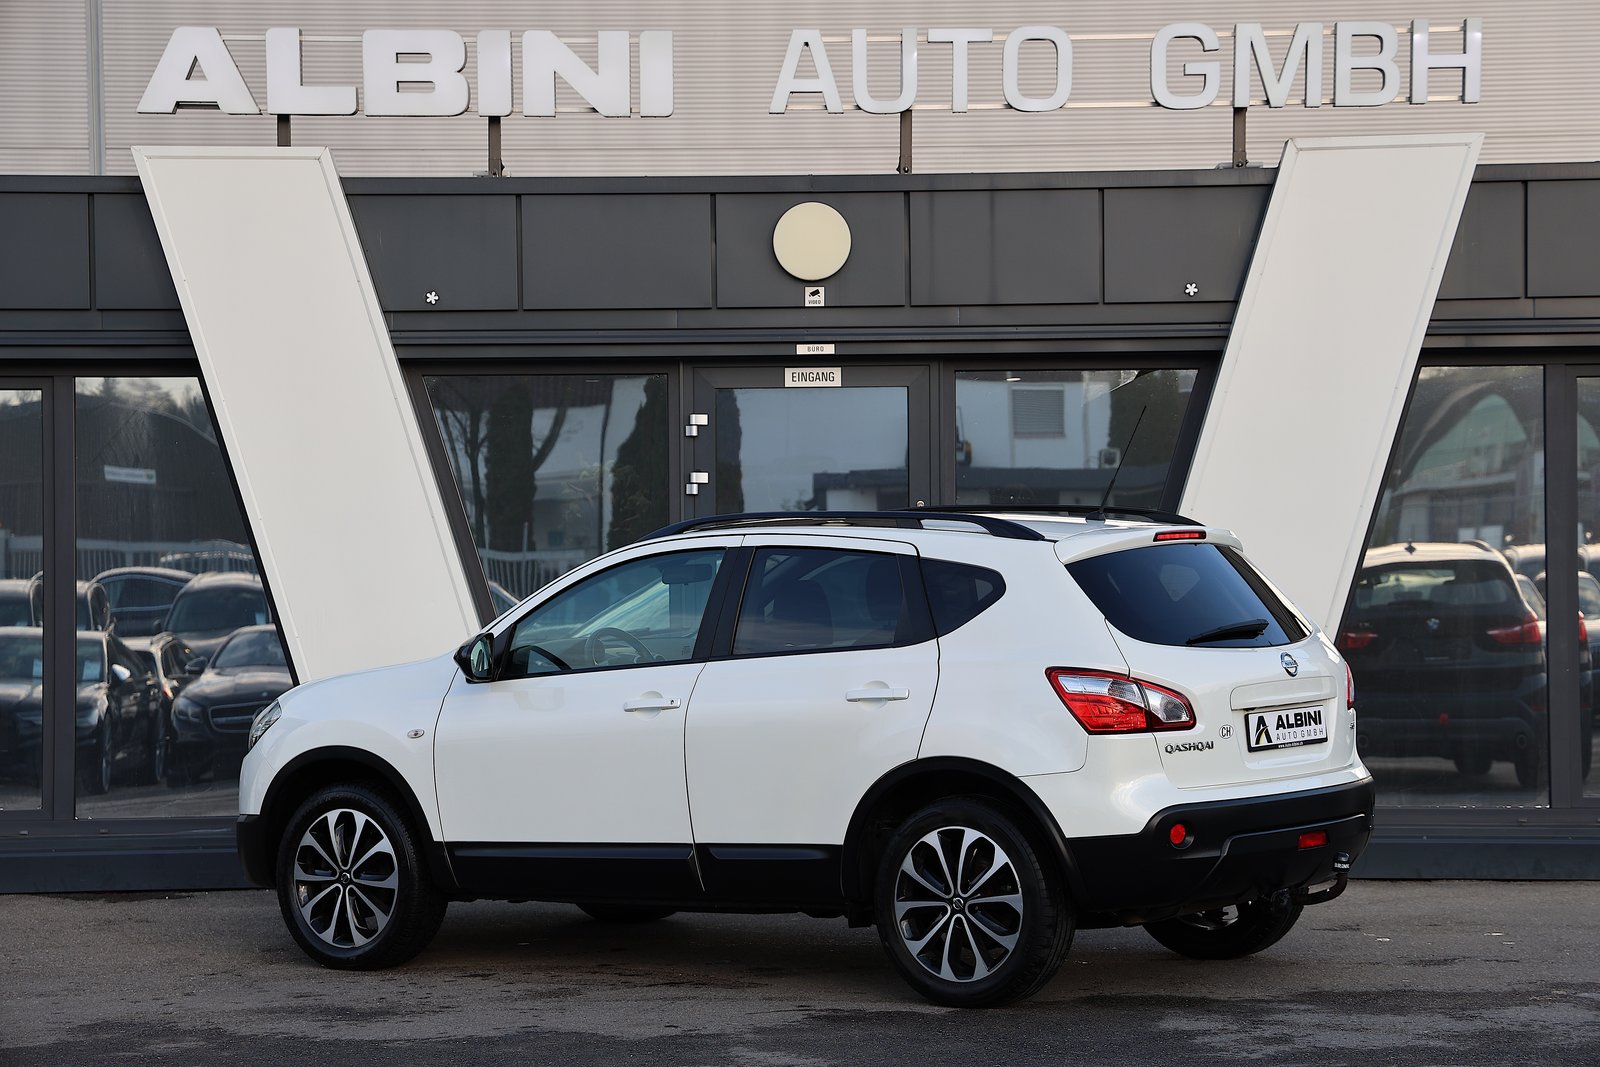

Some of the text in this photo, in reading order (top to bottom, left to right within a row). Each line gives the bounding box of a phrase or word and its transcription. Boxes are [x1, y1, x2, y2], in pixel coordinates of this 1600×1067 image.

[136, 17, 1483, 118] ALBINI AUTO GMBH
[791, 371, 835, 383] EINGANG
[1276, 710, 1322, 730] ALBINI
[1221, 726, 1231, 737] CH
[1276, 728, 1324, 741] AUTO GMBH
[1164, 740, 1214, 754] QASHQAI
